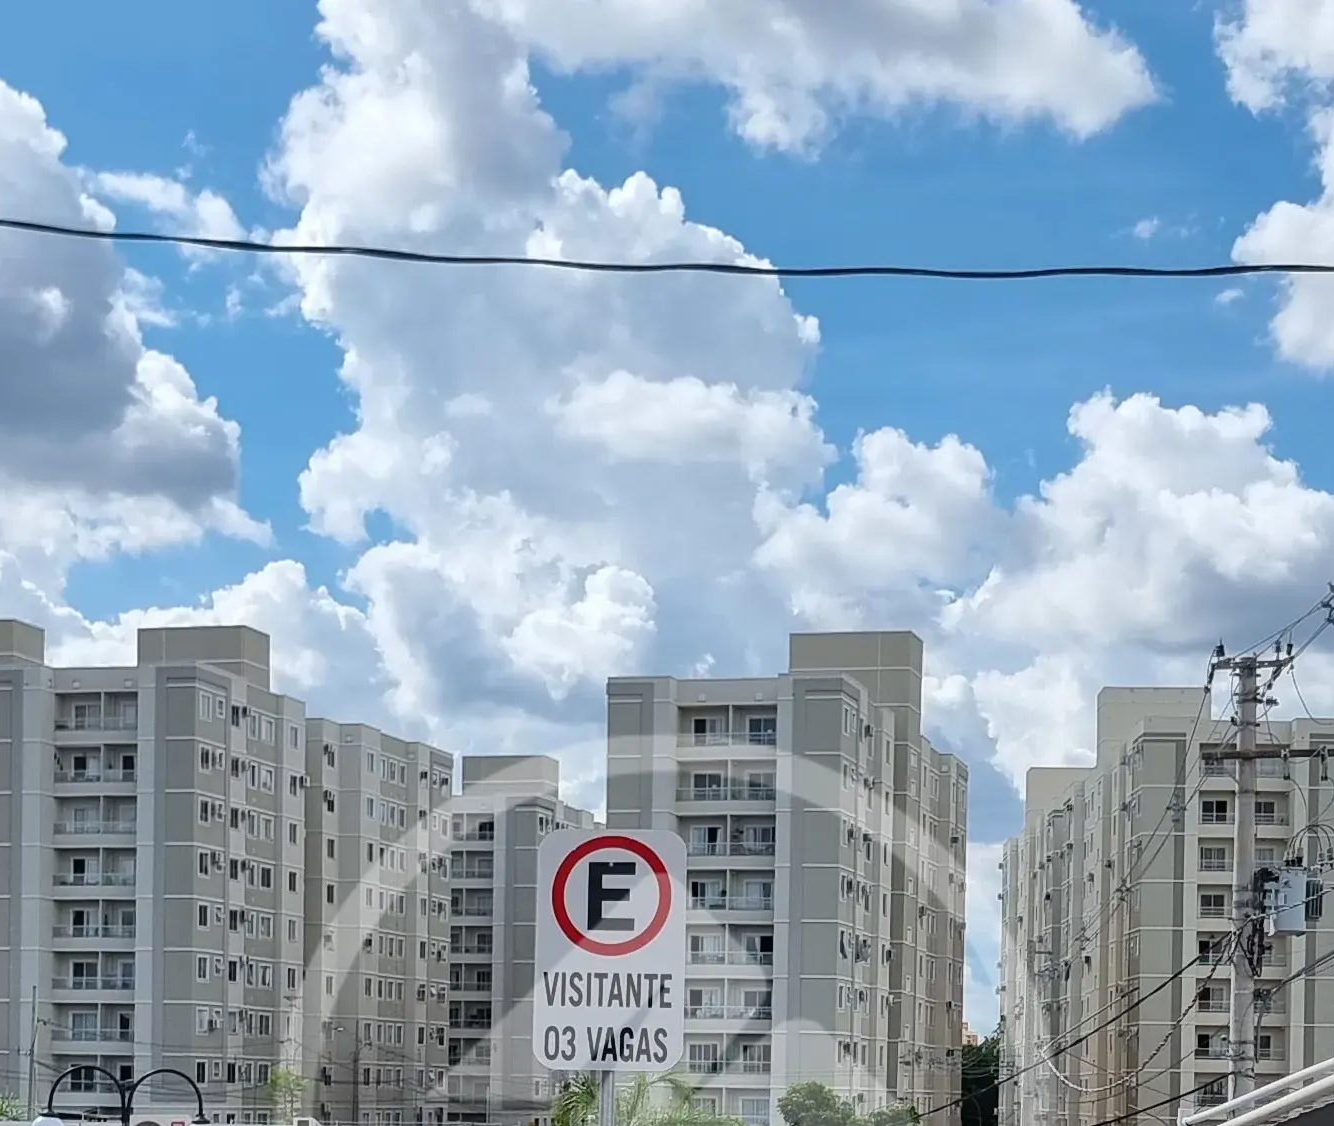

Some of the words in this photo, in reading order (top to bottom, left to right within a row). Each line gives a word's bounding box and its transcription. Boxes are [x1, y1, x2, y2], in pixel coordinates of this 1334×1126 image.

[587, 862, 637, 931] E
[544, 972, 673, 1008] VISITANTE
[544, 1025, 576, 1061] 03
[587, 1026, 668, 1063] VAGAS
